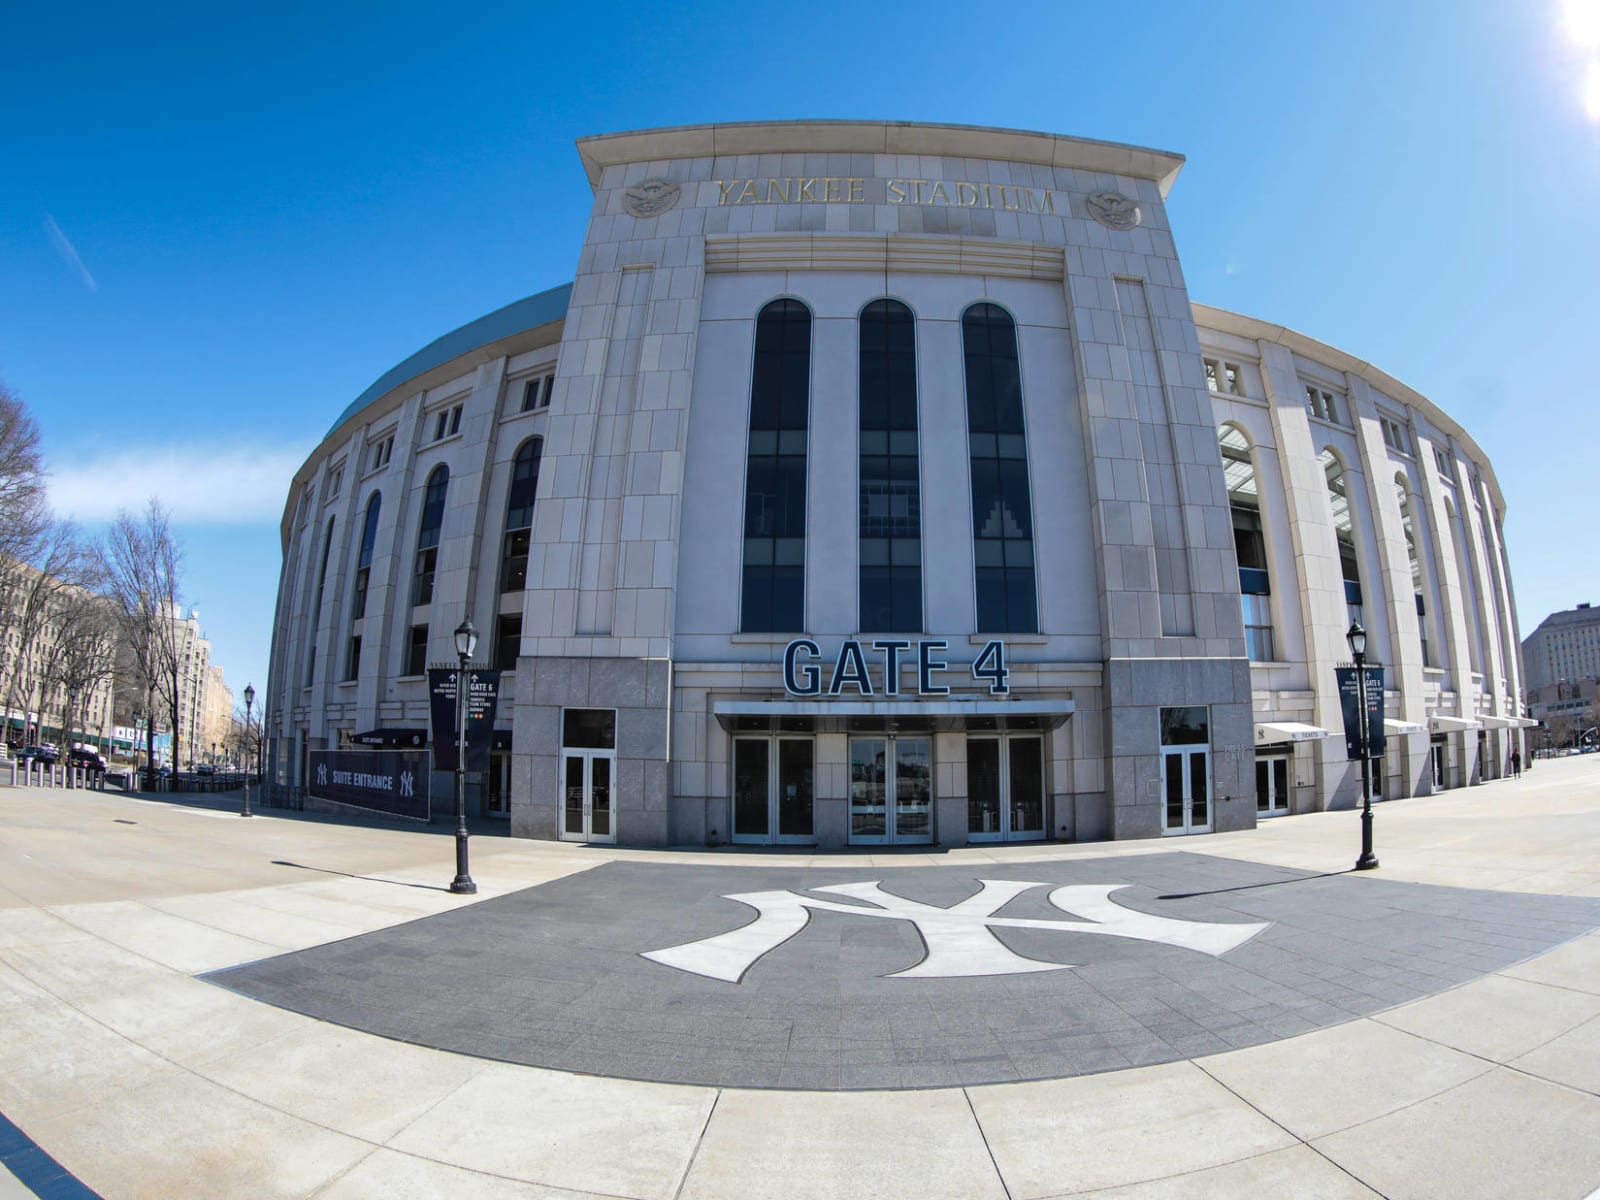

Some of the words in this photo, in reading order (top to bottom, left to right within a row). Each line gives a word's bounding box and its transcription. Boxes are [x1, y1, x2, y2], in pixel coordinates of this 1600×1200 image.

[714, 177, 865, 206] YANKEE
[886, 179, 1056, 216] STADIUM
[783, 638, 950, 697] GATE
[971, 639, 1010, 696] 4
[470, 683, 487, 691] GATE
[332, 770, 353, 786] SUITE
[353, 772, 393, 791] ENTRANCE
